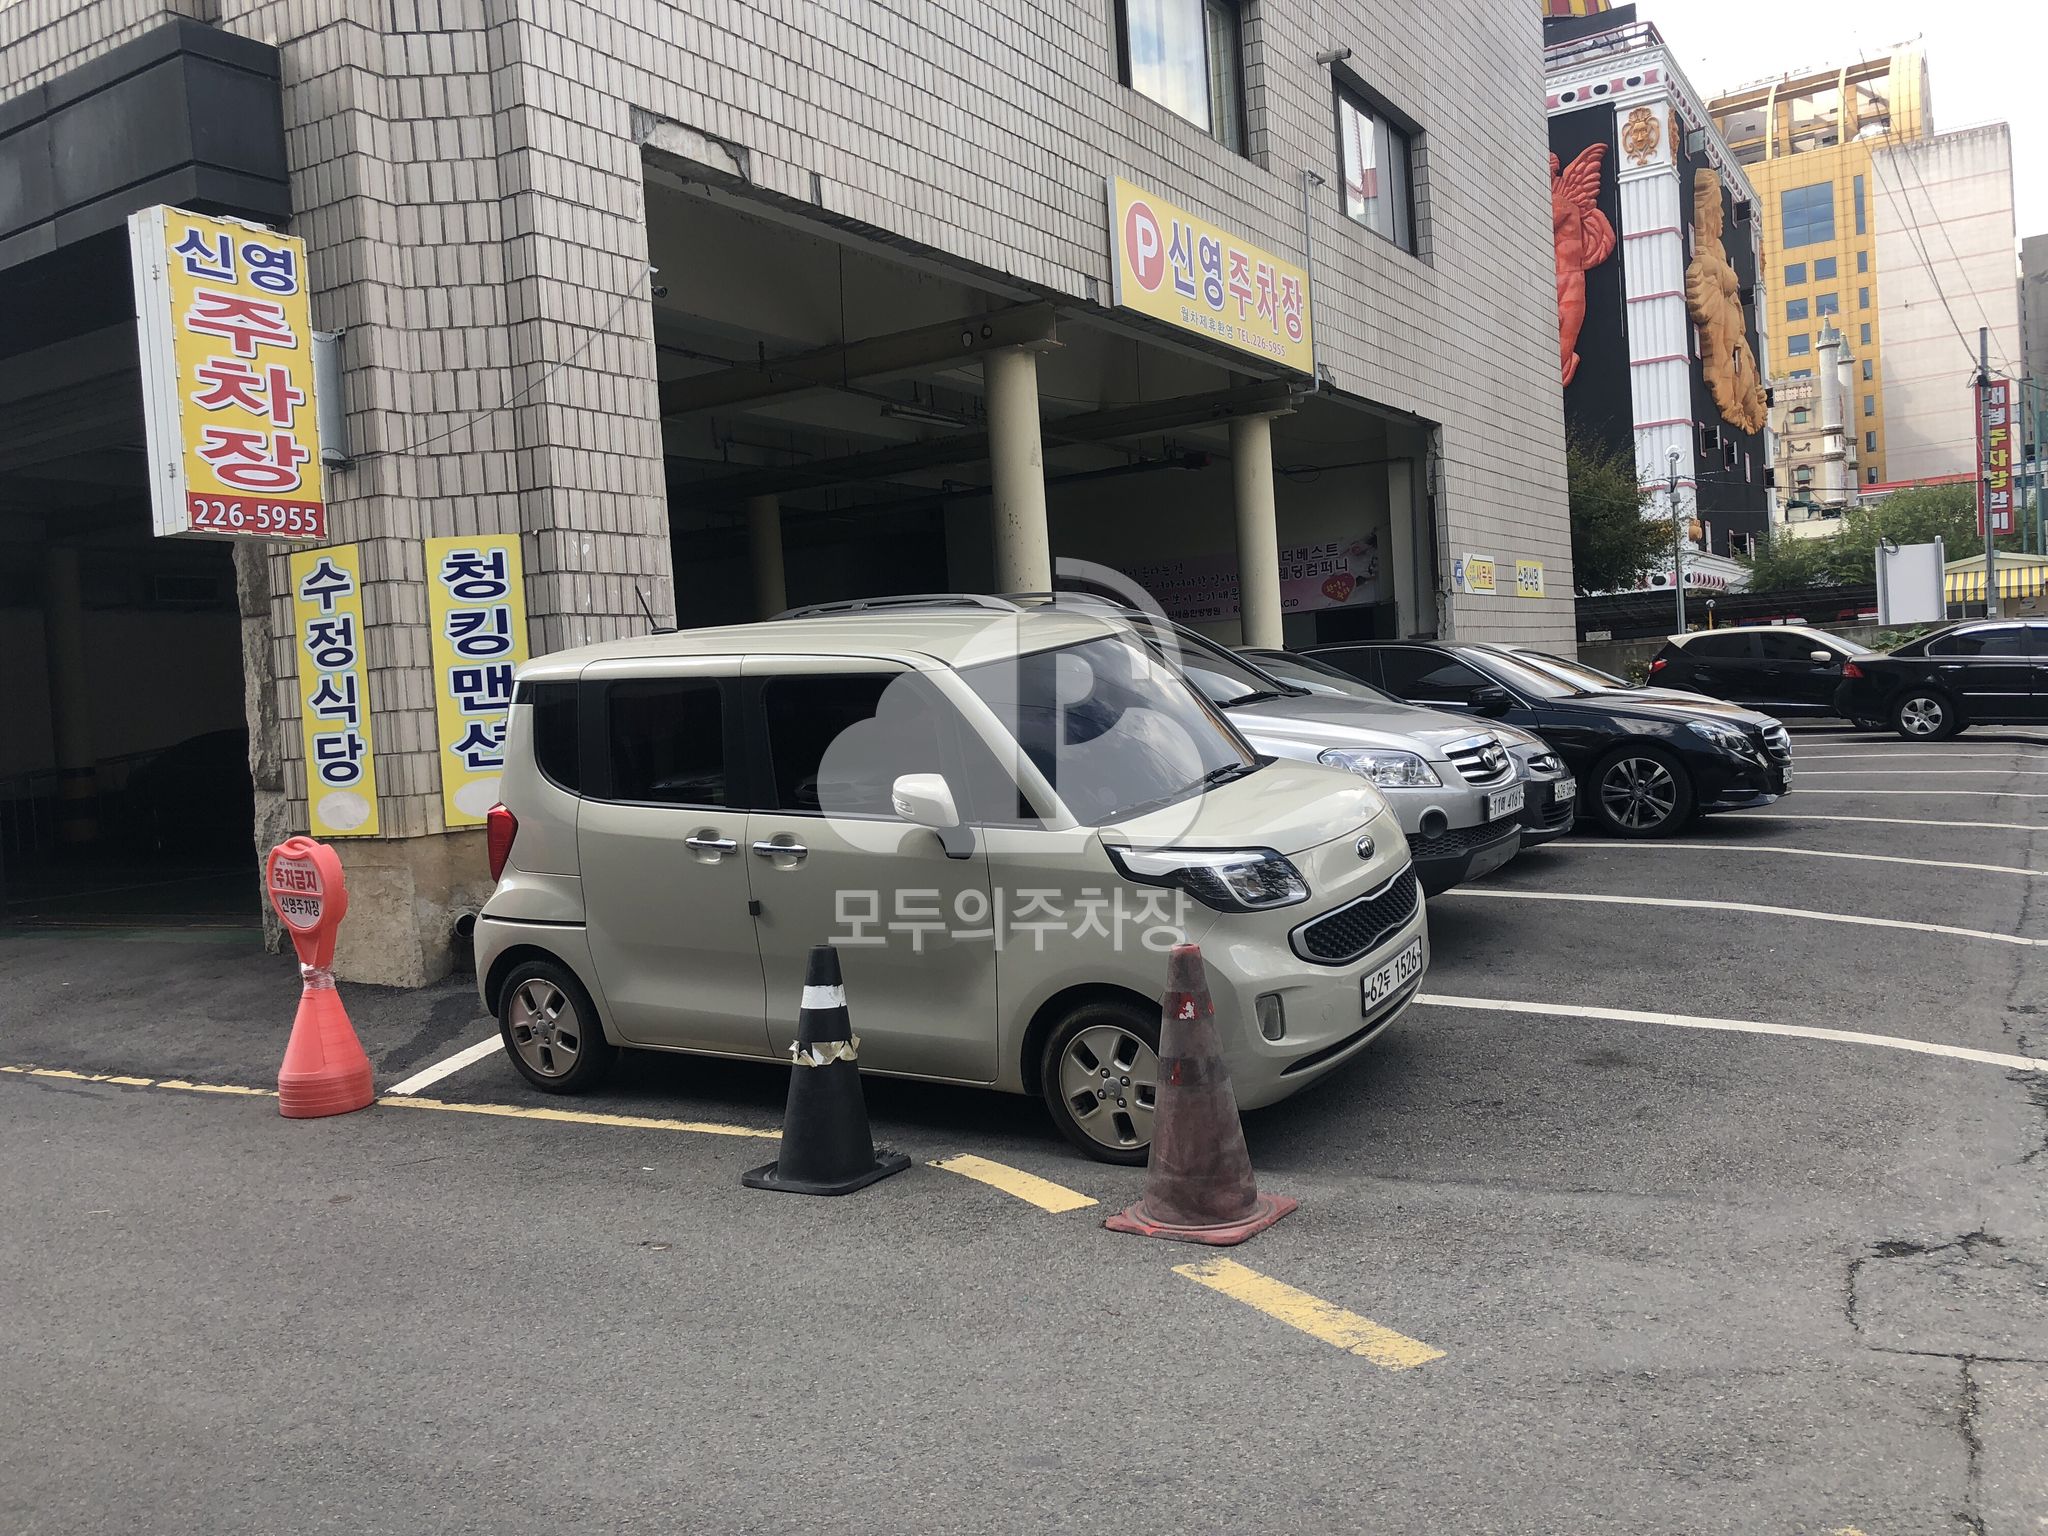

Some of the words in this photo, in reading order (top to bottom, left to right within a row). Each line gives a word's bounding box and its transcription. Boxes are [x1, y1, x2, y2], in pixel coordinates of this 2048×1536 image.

[174, 229, 296, 293] 신영
[1135, 213, 1160, 277] P
[1168, 220, 1304, 341] 신영주차장
[188, 291, 307, 489] 주차장
[193, 501, 319, 531] 226-5955
[1281, 543, 1339, 562] 더베스트
[1476, 563, 1492, 585] 사무실
[1516, 564, 1539, 591] 수정식당
[303, 562, 363, 783] 수정식당
[275, 867, 318, 891] 주차금지
[1370, 968, 1392, 1002] 62두
[1395, 946, 1418, 983] 1526
